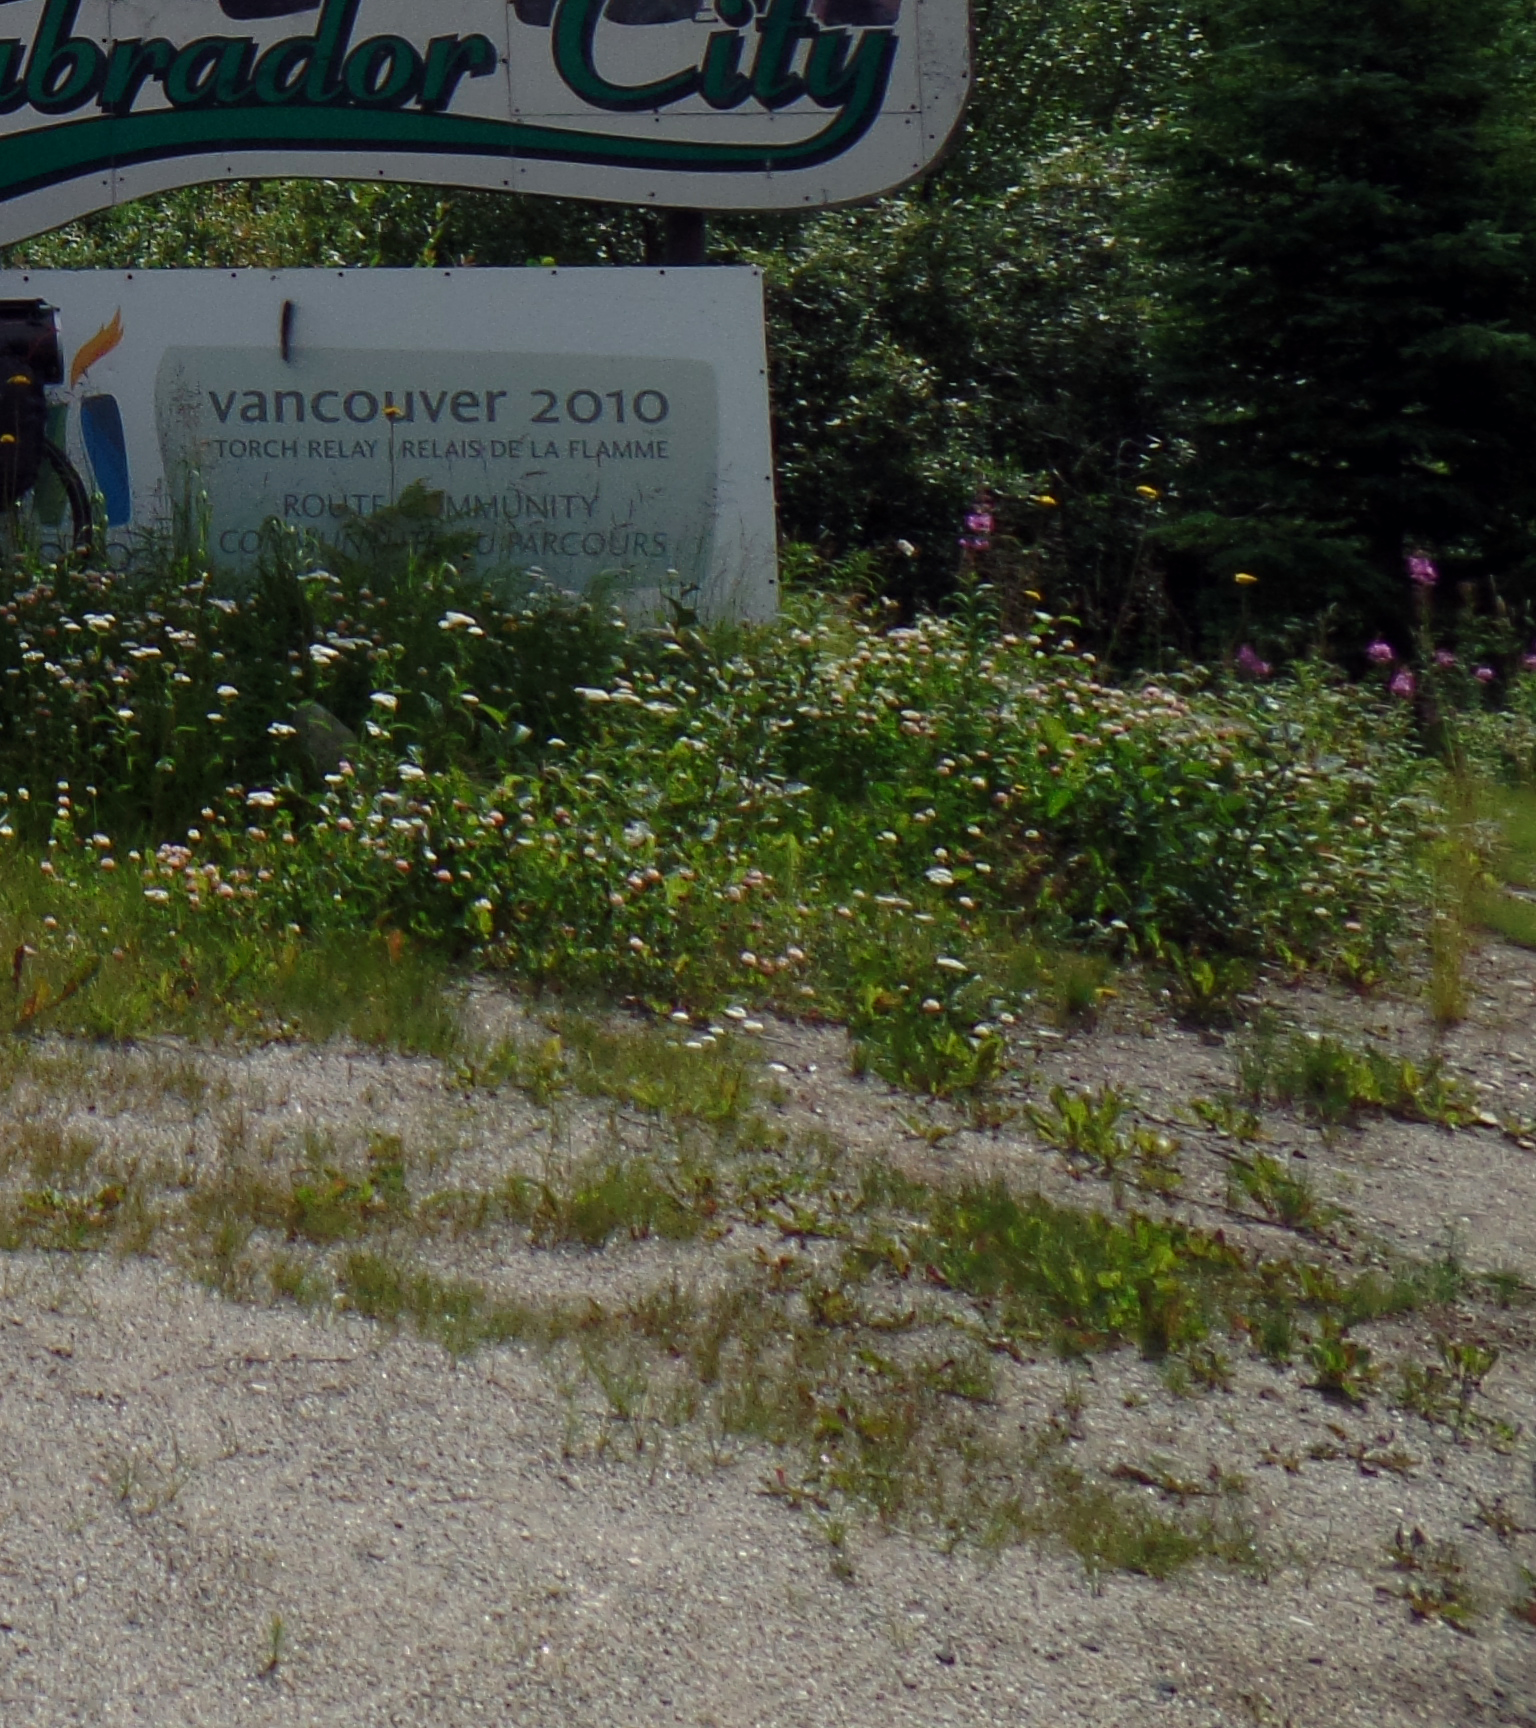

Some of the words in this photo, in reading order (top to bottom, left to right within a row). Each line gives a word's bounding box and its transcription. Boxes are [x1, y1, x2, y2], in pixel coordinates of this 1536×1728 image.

[208, 388, 508, 424] vancouver
[530, 388, 670, 424] 2010
[214, 439, 298, 459] TORCH
[307, 439, 378, 459] RELAY
[402, 439, 484, 459] RELAIS
[490, 439, 523, 459] DE
[531, 439, 560, 459] LA
[569, 439, 670, 459] FLAMME
[508, 532, 669, 556] PARCOURS
